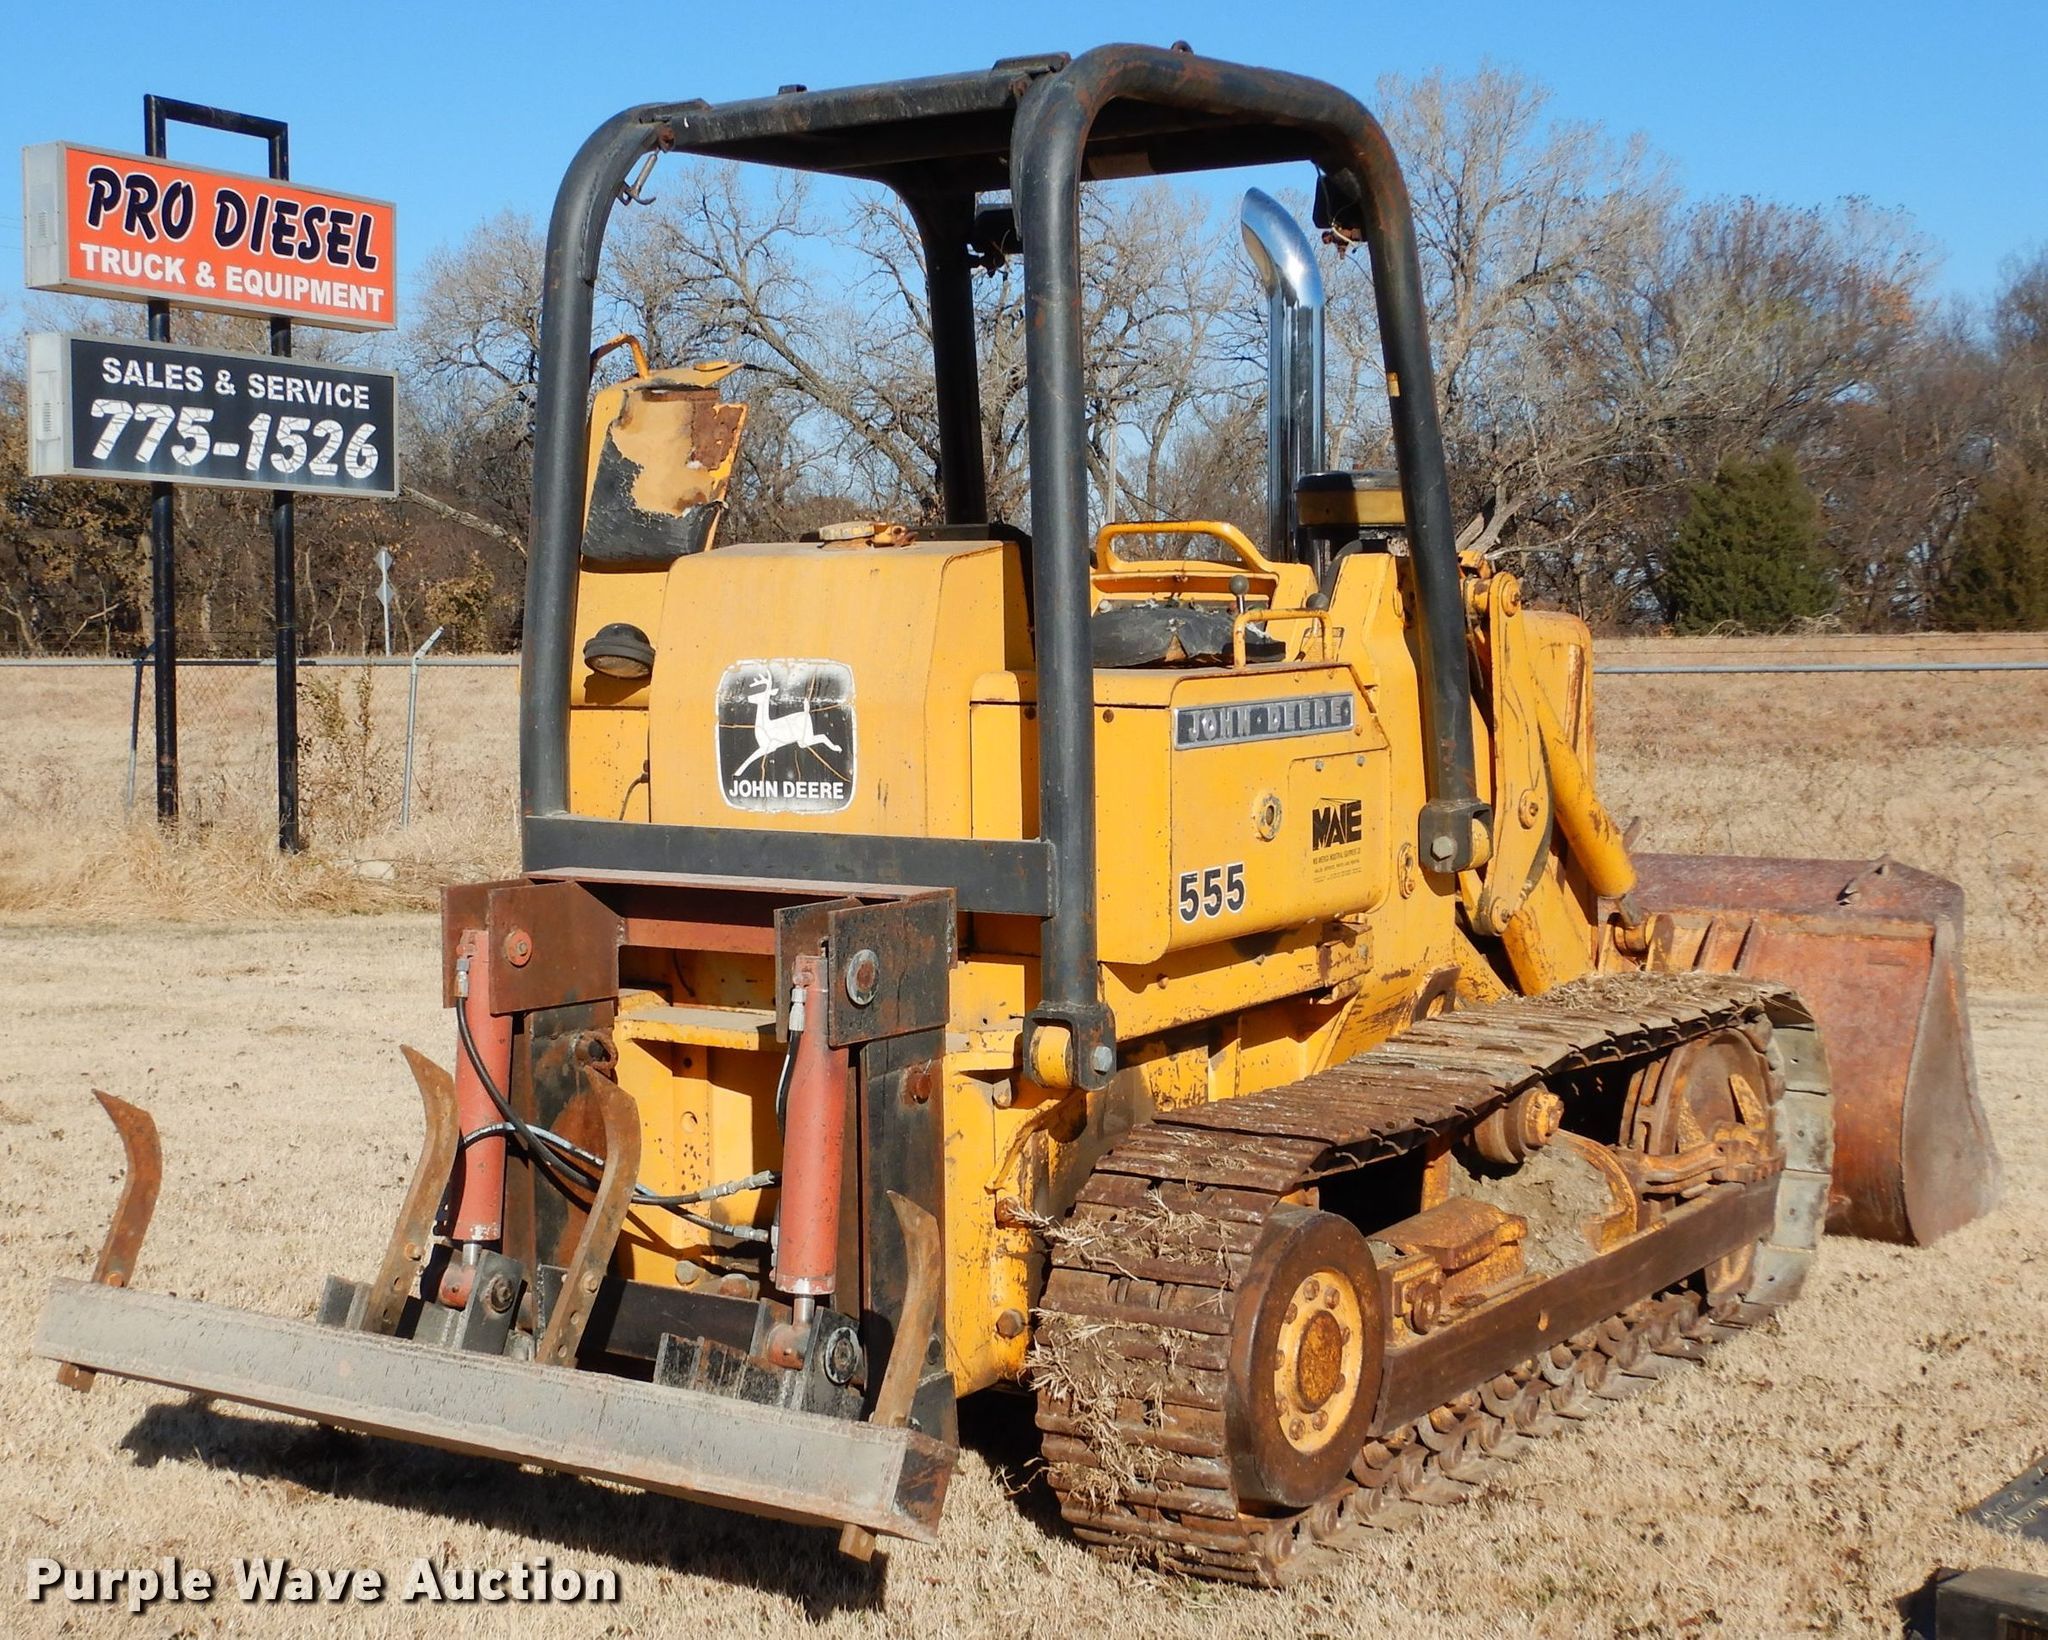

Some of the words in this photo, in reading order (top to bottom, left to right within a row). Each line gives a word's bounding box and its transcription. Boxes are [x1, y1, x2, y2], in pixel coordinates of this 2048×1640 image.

[86, 164, 196, 243] PRO
[212, 187, 379, 271] DIESEL
[80, 243, 186, 284] TRUCK
[195, 261, 216, 289] &
[226, 266, 384, 313] EQUIPMENT
[102, 357, 205, 393] SALES
[215, 368, 237, 396] &
[248, 373, 370, 410] SERVICE
[90, 399, 379, 479] 775-1526
[1188, 706, 1250, 742] JOHN
[1267, 697, 1342, 732] DEERE
[729, 779, 778, 797] JOHN
[783, 781, 845, 799] DEERE
[1179, 861, 1246, 923] 555
